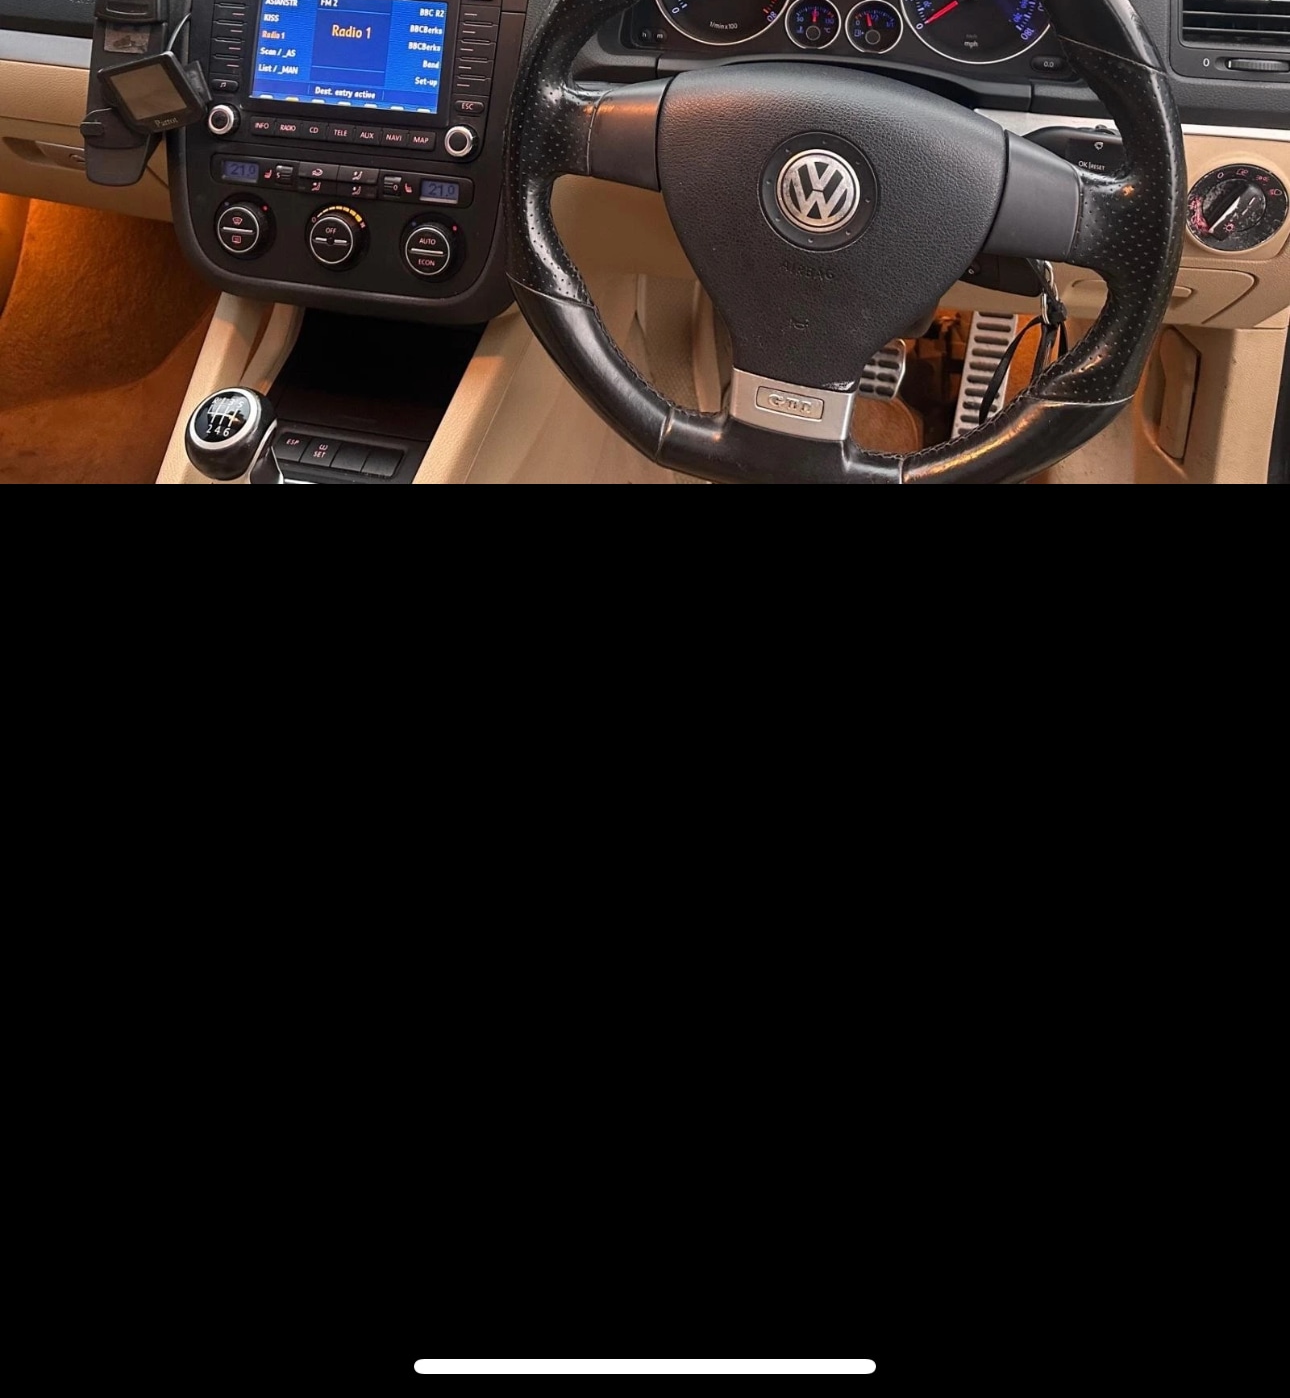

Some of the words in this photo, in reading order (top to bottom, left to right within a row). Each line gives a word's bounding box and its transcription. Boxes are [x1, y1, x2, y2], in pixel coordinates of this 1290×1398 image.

[419, 9, 434, 17] BBC
[264, 14, 279, 22] KISS
[262, 31, 279, 39] Radio
[332, 25, 362, 39] Radio
[366, 27, 371, 39] 1
[422, 60, 439, 69] Band
[1202, 58, 1210, 67] 0
[258, 64, 272, 73] List
[414, 77, 437, 87] Set-up
[315, 87, 333, 96] Dest.
[335, 88, 353, 98] entry
[354, 90, 376, 99] active
[461, 103, 473, 111] ESC
[255, 122, 269, 130] INFO
[280, 124, 296, 132] RADIO
[309, 126, 319, 134] CD
[334, 129, 348, 137] TELE
[386, 134, 402, 142] NAVI
[413, 136, 429, 144] MAP
[428, 183, 456, 198] 21.0
[777, 149, 860, 232] VW
[419, 237, 436, 246] AUTO
[418, 258, 435, 267] ECON
[206, 424, 212, 433] 2
[214, 426, 220, 435] 4
[223, 427, 230, 437] 6
